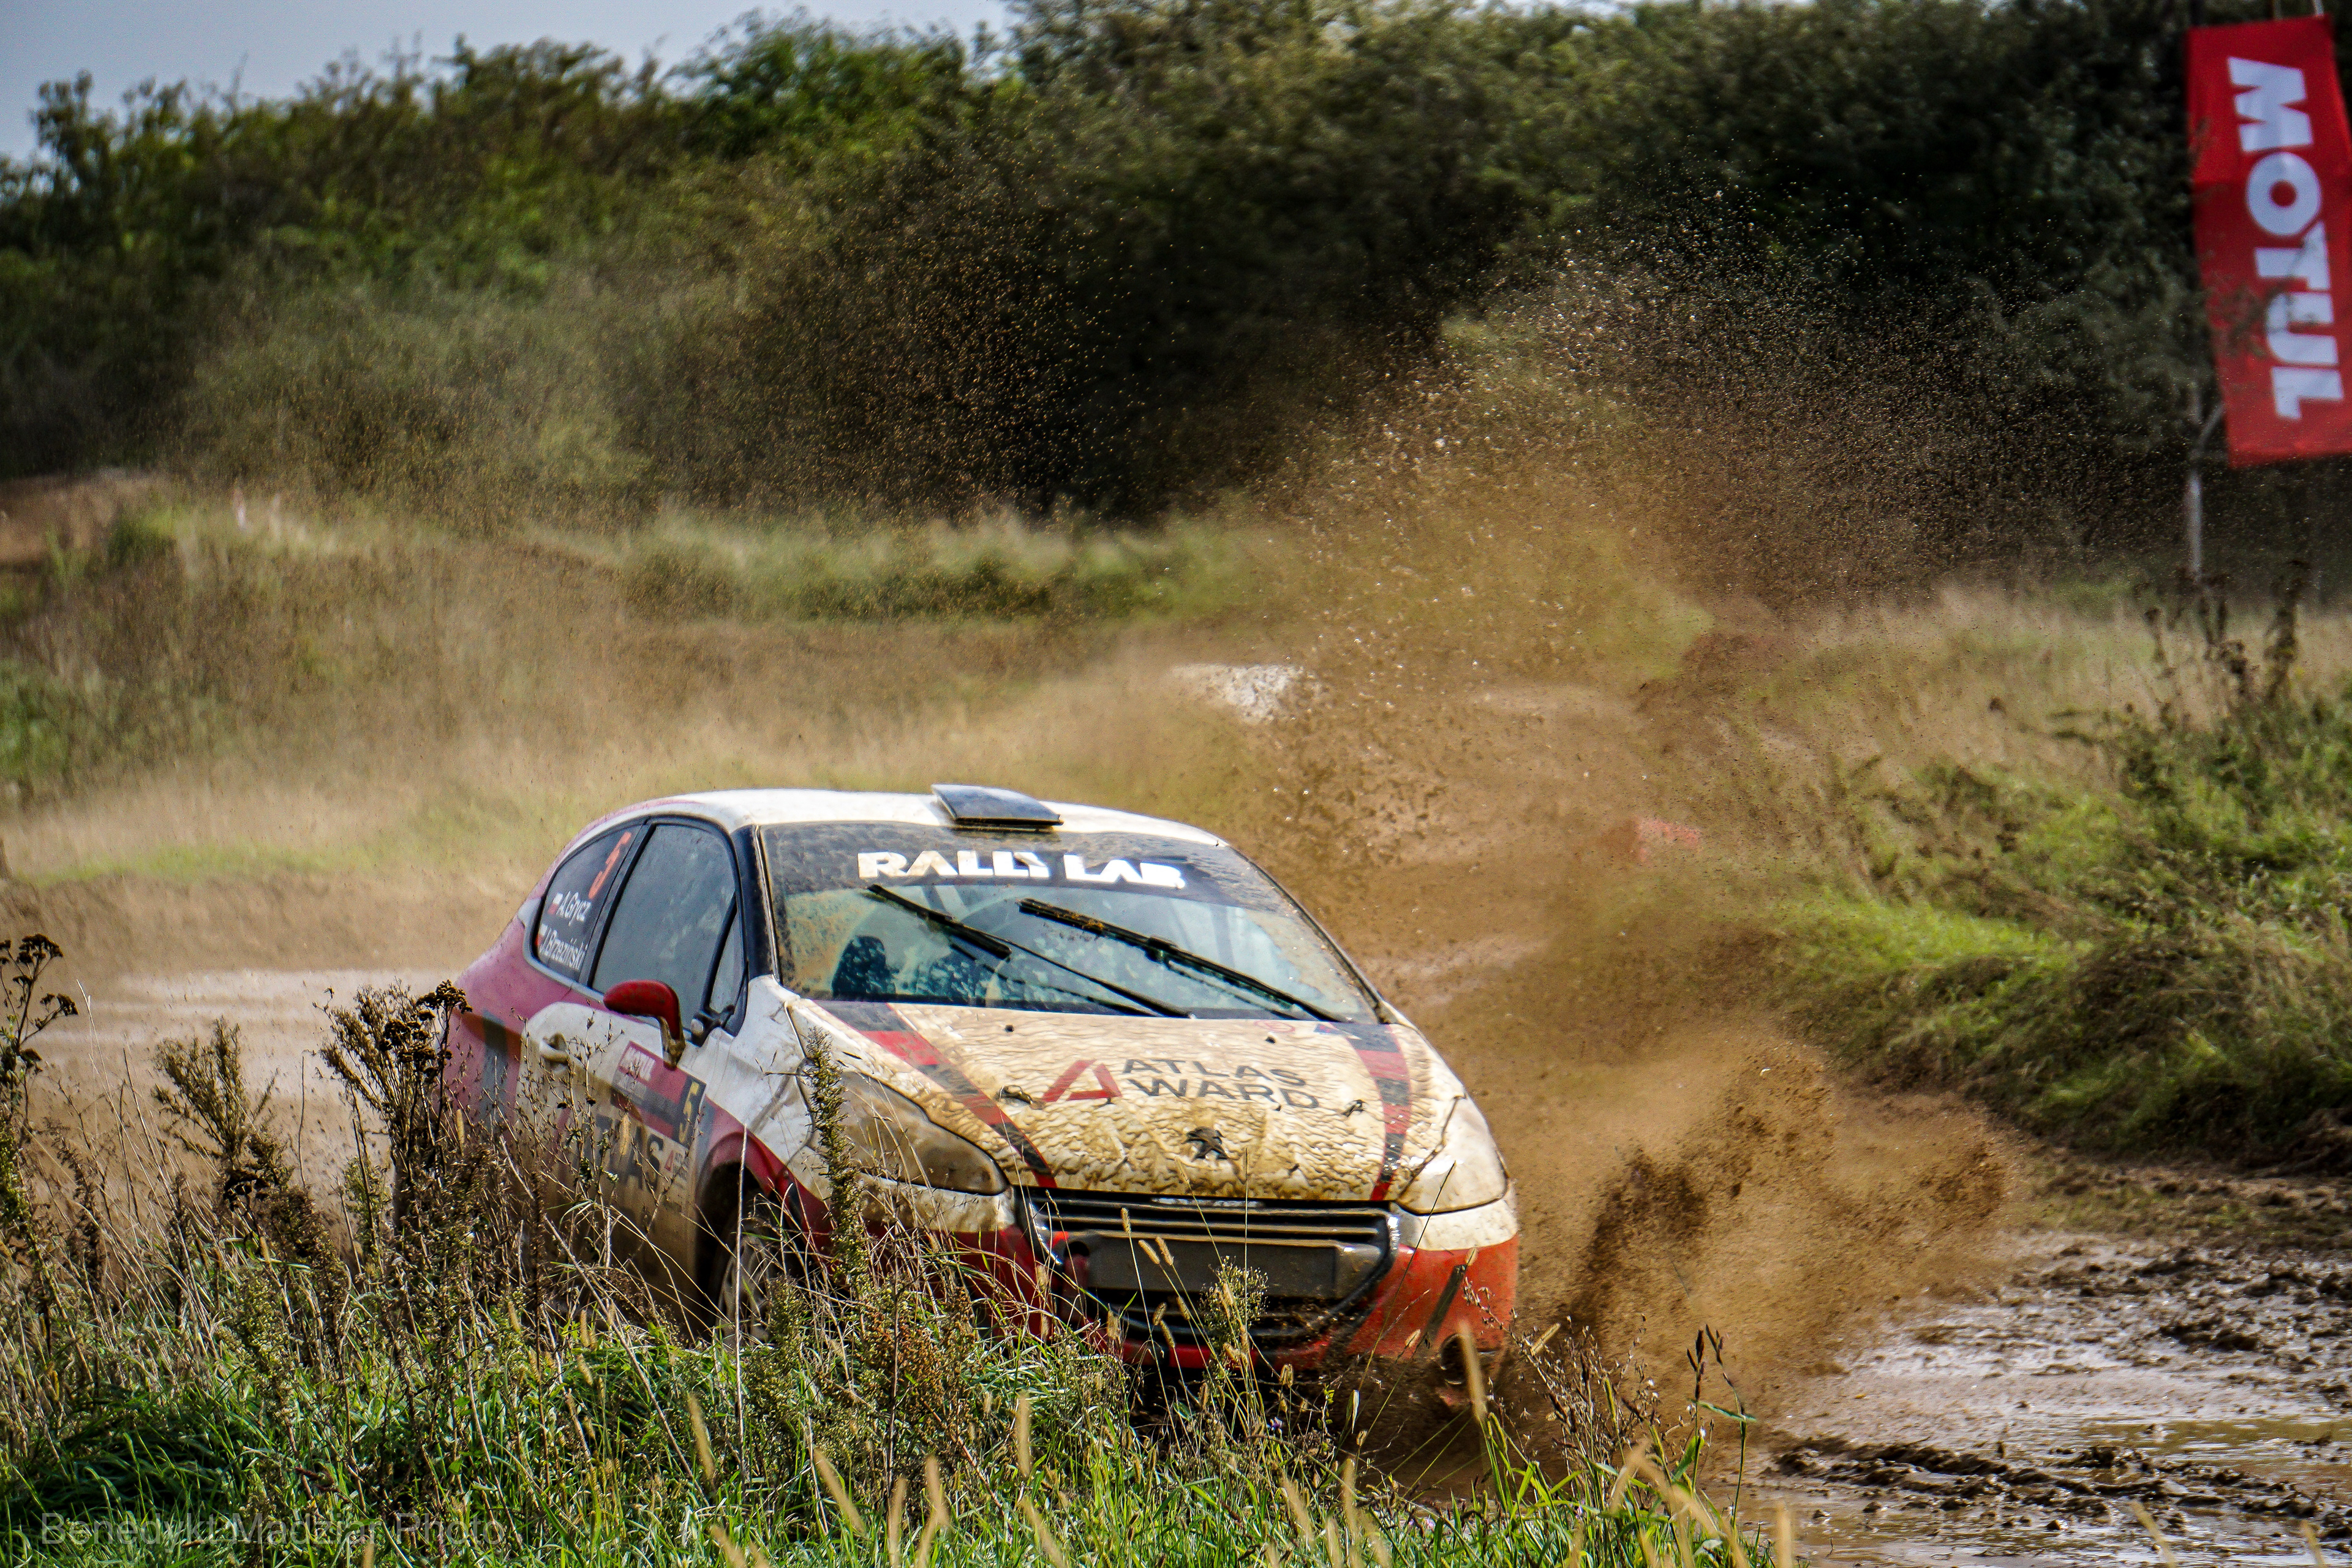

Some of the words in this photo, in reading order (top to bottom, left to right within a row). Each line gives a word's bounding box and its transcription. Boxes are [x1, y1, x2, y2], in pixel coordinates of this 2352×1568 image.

[2227, 56, 2344, 420] MOTUL
[588, 831, 633, 900] 5
[858, 850, 1050, 878] RALLY
[1063, 853, 1186, 889] LAB
[1123, 1058, 1307, 1087] ATLAS
[1126, 1078, 1321, 1109] WARD
[678, 1080, 701, 1144] 5
